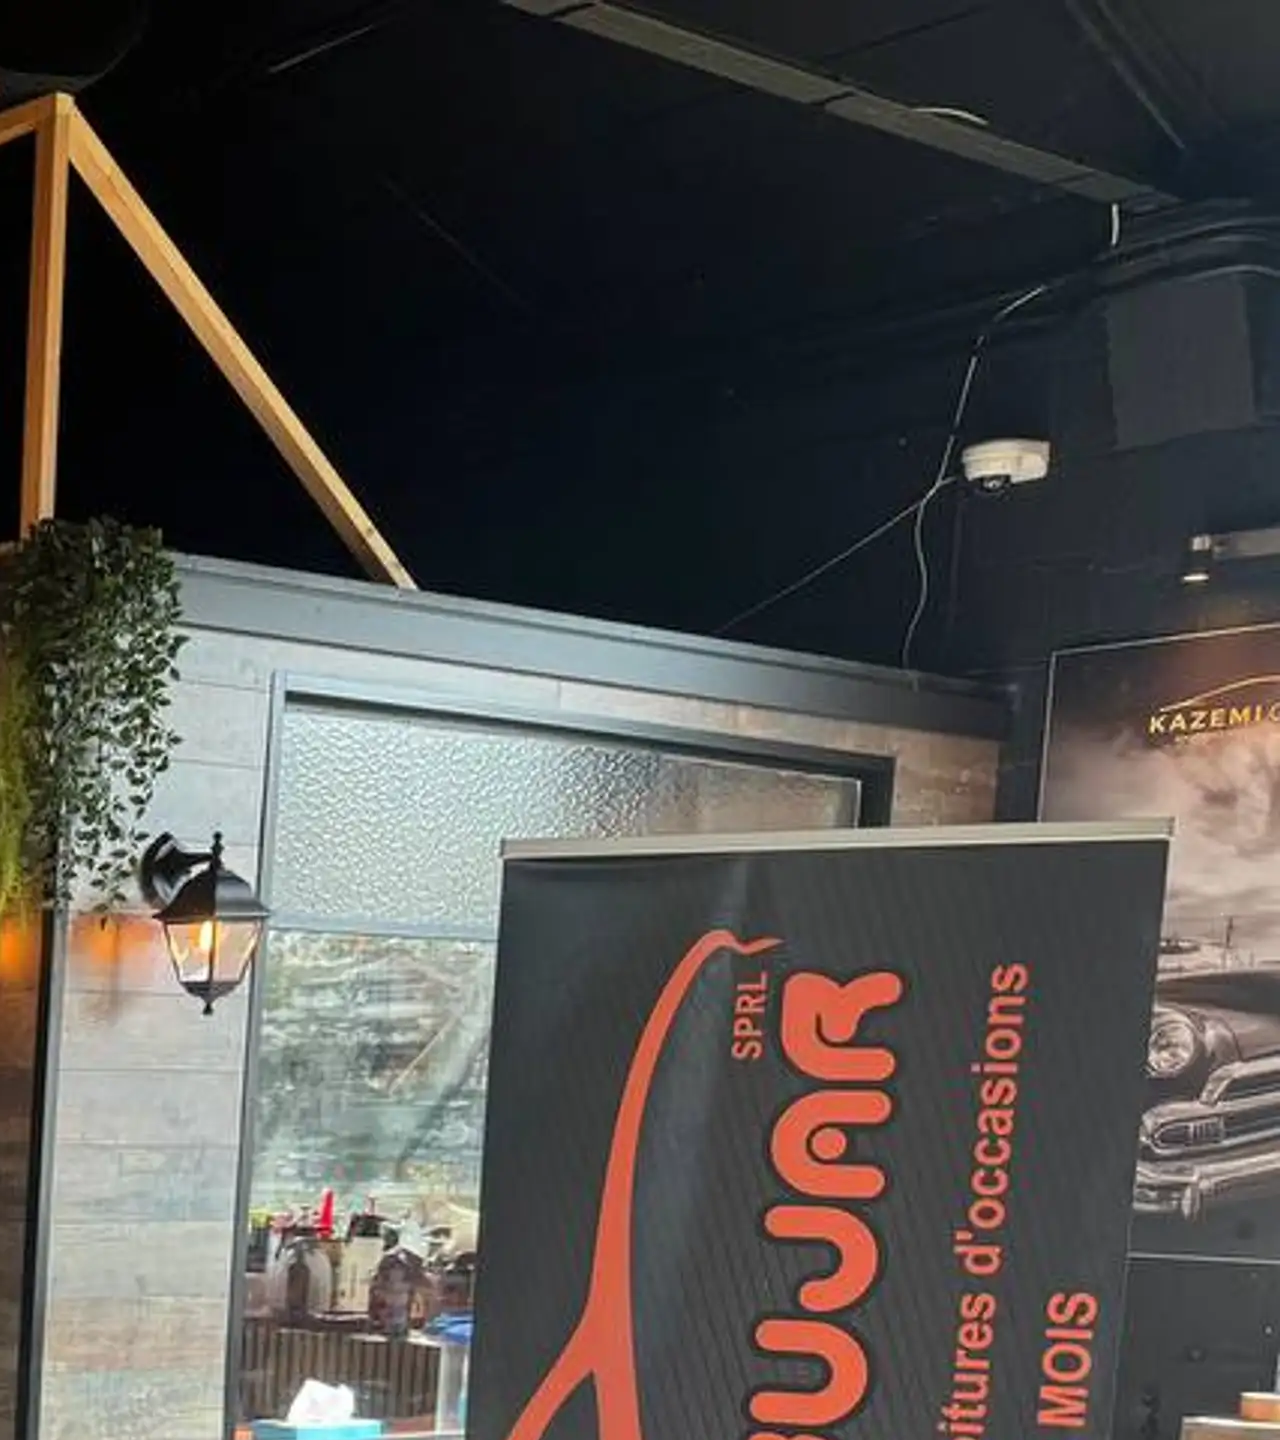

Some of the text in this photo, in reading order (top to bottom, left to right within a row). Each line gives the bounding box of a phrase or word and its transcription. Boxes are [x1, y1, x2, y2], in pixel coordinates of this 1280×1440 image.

[1149, 705, 1262, 734] KAZEMI
[732, 973, 768, 1061] SPRL
[954, 962, 1030, 1277] d'occasions
[1038, 1291, 1099, 1430] MOIS
